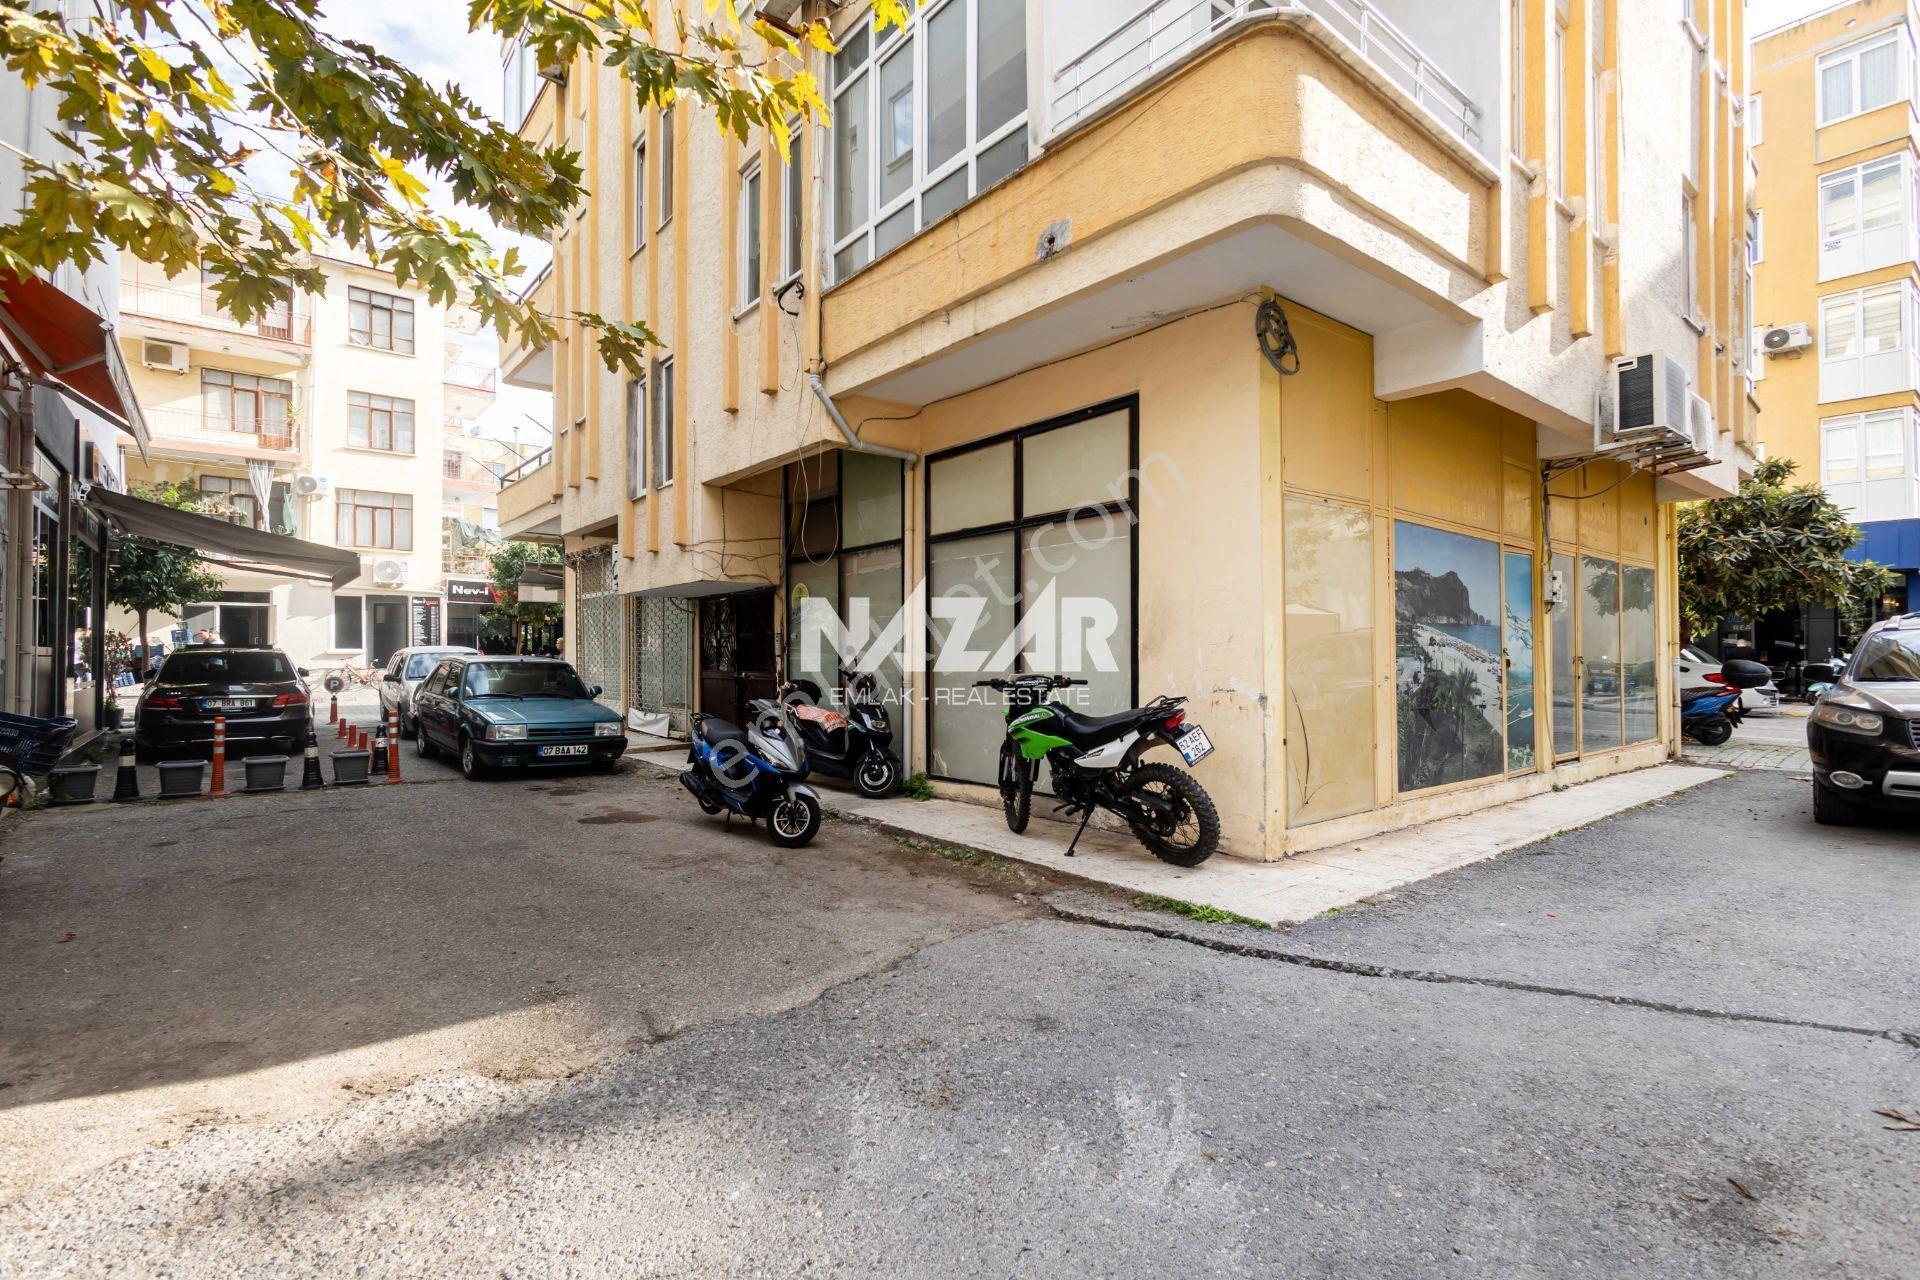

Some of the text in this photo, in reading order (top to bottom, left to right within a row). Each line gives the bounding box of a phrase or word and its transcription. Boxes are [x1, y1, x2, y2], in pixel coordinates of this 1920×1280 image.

[452, 584, 489, 595] Nev-i
[330, 680, 340, 689] P
[207, 699, 217, 707] 07
[221, 699, 236, 707] BRA
[1178, 728, 1202, 751] 52 AEF
[543, 746, 587, 755] 07 BAA 142
[1191, 742, 1206, 757] 262
